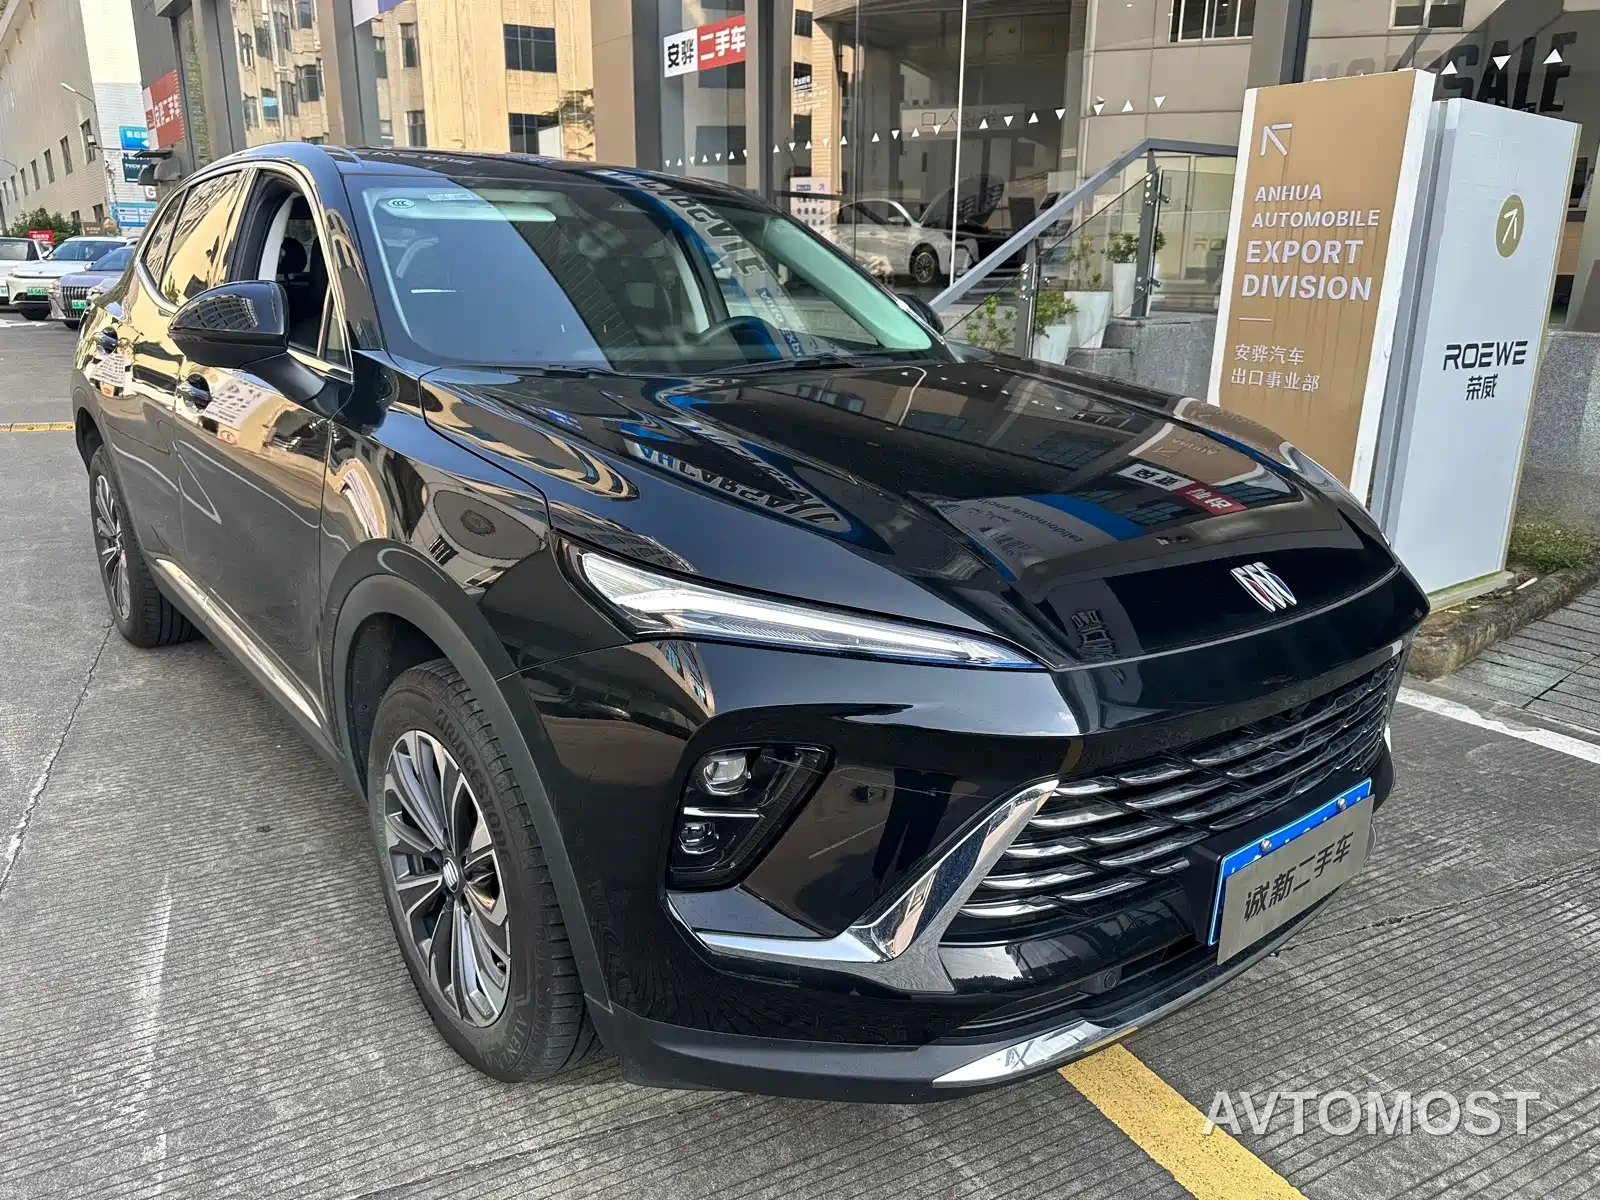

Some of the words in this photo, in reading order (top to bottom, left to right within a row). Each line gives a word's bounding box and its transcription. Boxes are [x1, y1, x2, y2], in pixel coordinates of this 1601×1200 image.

[1254, 183, 1323, 202] ANHUA
[1251, 209, 1381, 229] AUTOMOBILE
[1245, 239, 1364, 265] EXPORT
[1241, 274, 1373, 302] DIVISION
[1234, 343, 1305, 367] 安骅汽车
[1442, 340, 1529, 371] ROEWE
[1231, 367, 1320, 394] 出口事业部
[1465, 373, 1499, 402] 荣威
[1243, 831, 1355, 923] 诚新二手车
